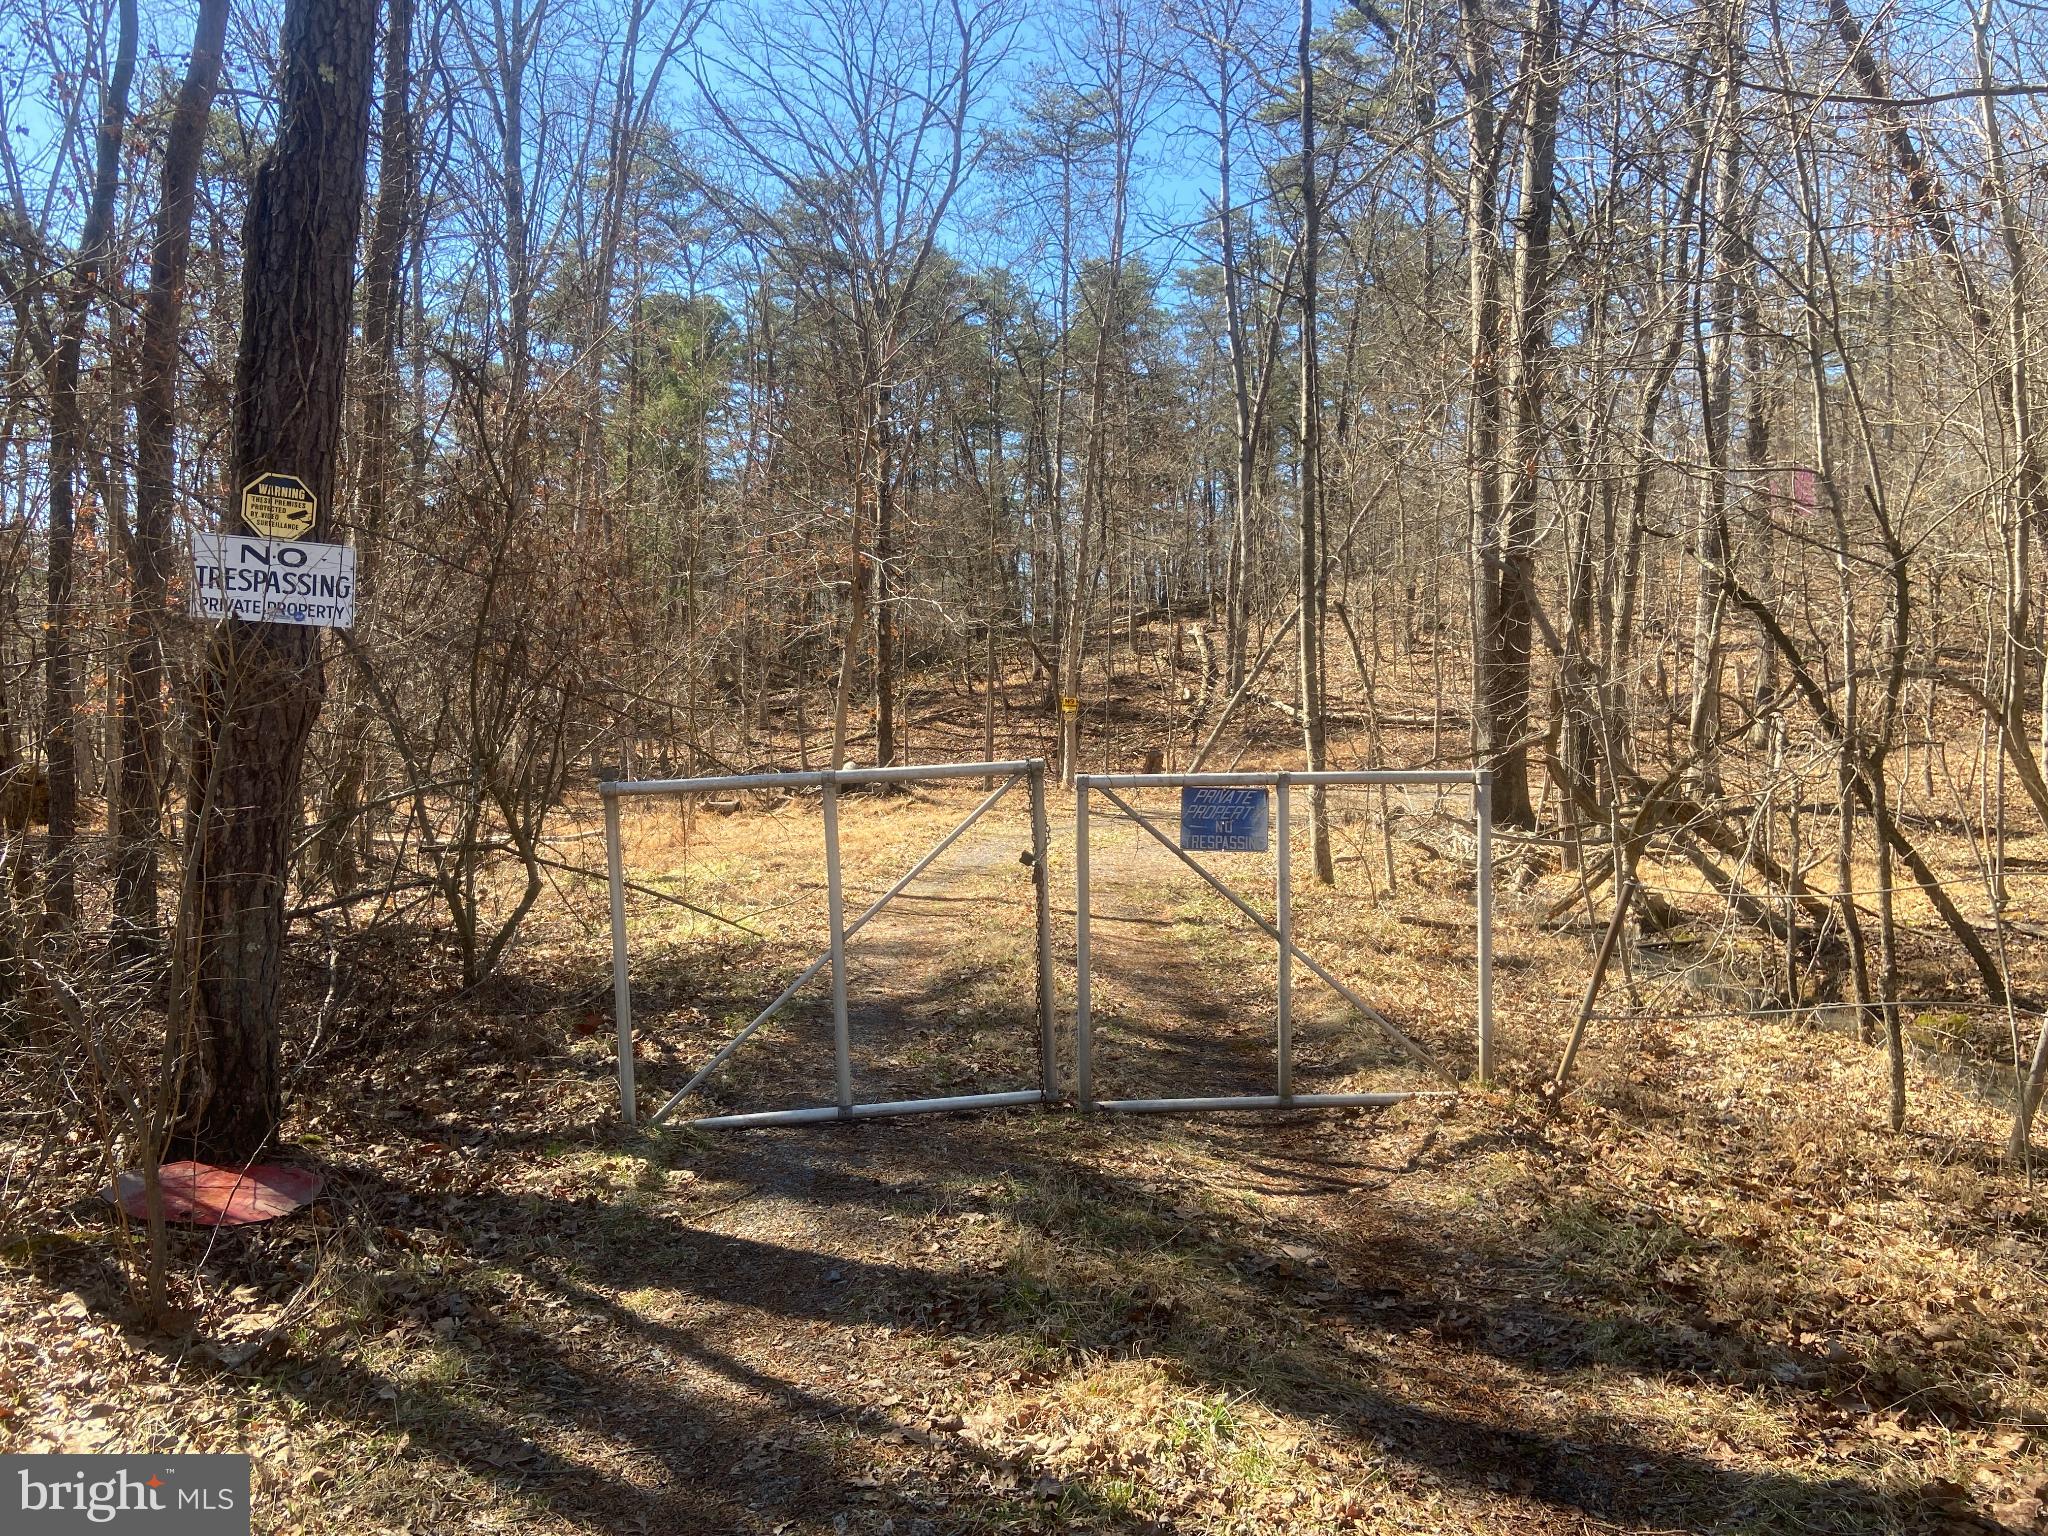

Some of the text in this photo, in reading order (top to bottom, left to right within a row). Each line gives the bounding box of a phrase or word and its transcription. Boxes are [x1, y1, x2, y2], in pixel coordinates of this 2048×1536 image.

[258, 483, 306, 500] WARNING
[250, 504, 287, 513] PROTECTED
[251, 496, 307, 509] THESE PREMISES
[261, 512, 279, 520] VIDEO
[240, 544, 308, 568] NO
[195, 565, 351, 599] TRESPASSING
[200, 596, 262, 614] PRIVATE
[267, 601, 345, 620] PROPERTY
[1193, 789, 1258, 804] PRIVATE
[1215, 820, 1233, 833] NO
